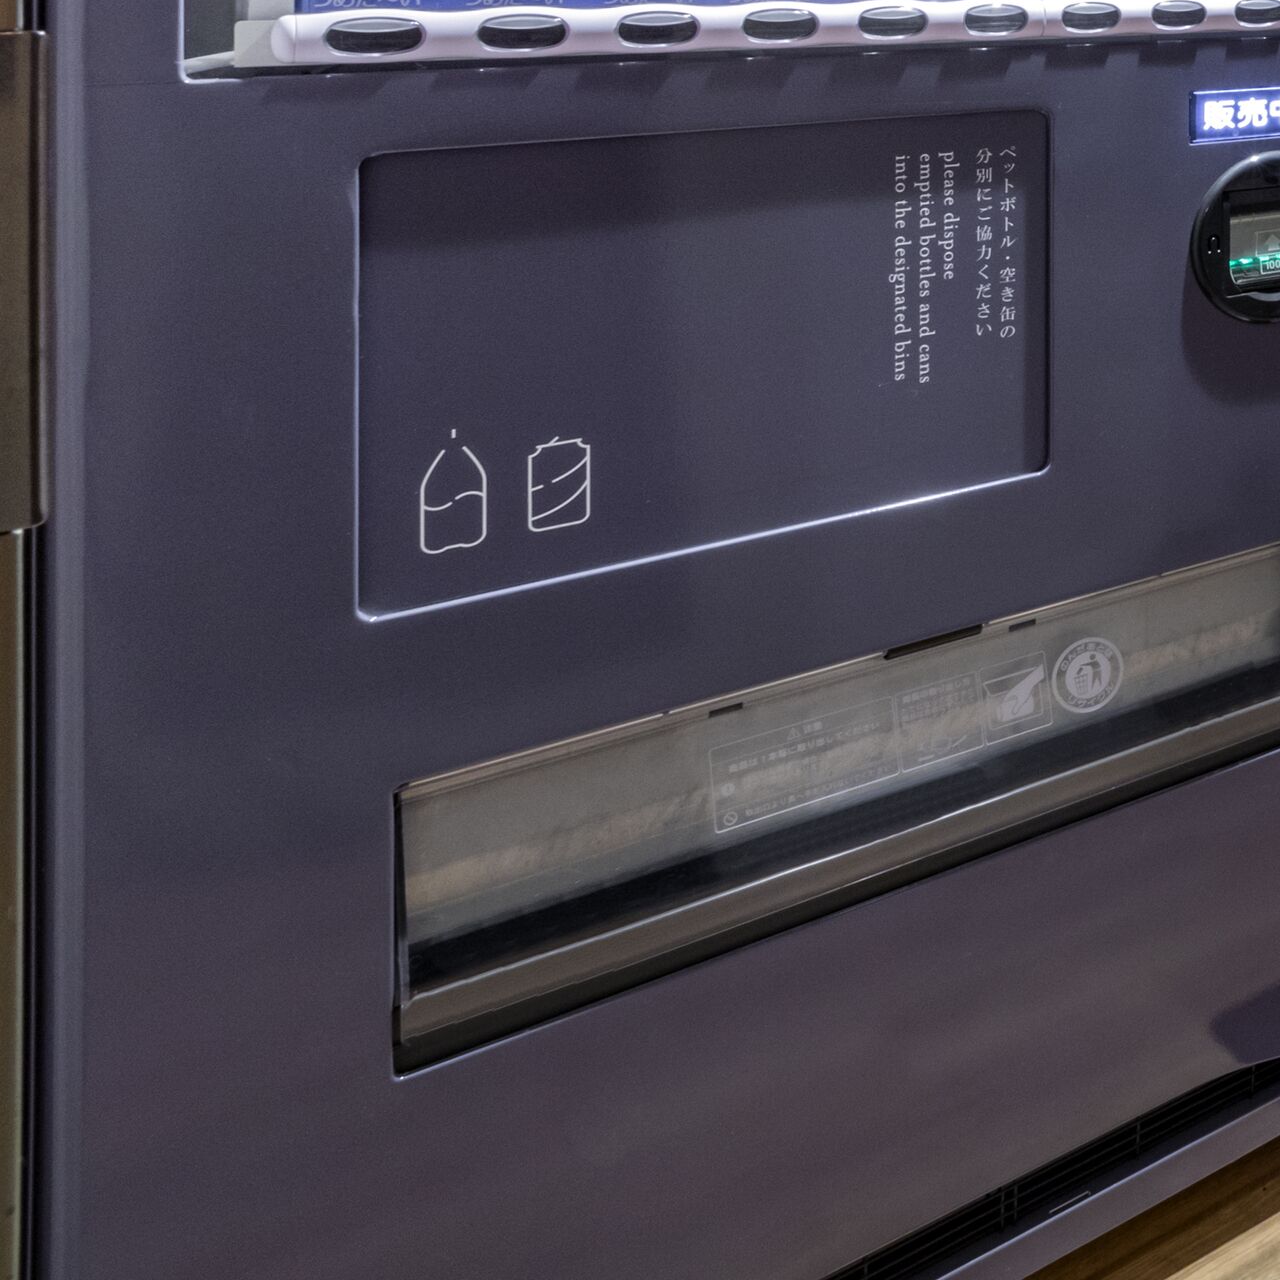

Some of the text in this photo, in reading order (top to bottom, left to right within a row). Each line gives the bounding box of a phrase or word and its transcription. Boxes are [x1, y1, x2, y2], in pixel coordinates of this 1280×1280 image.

[888, 155, 913, 382] into the designated bins
[914, 153, 937, 384] emptied bottles and cans
[938, 151, 961, 281] please dispose
[975, 147, 993, 337] 分別にご協力ください
[999, 145, 1017, 339] ペットボトル・空き缶の
